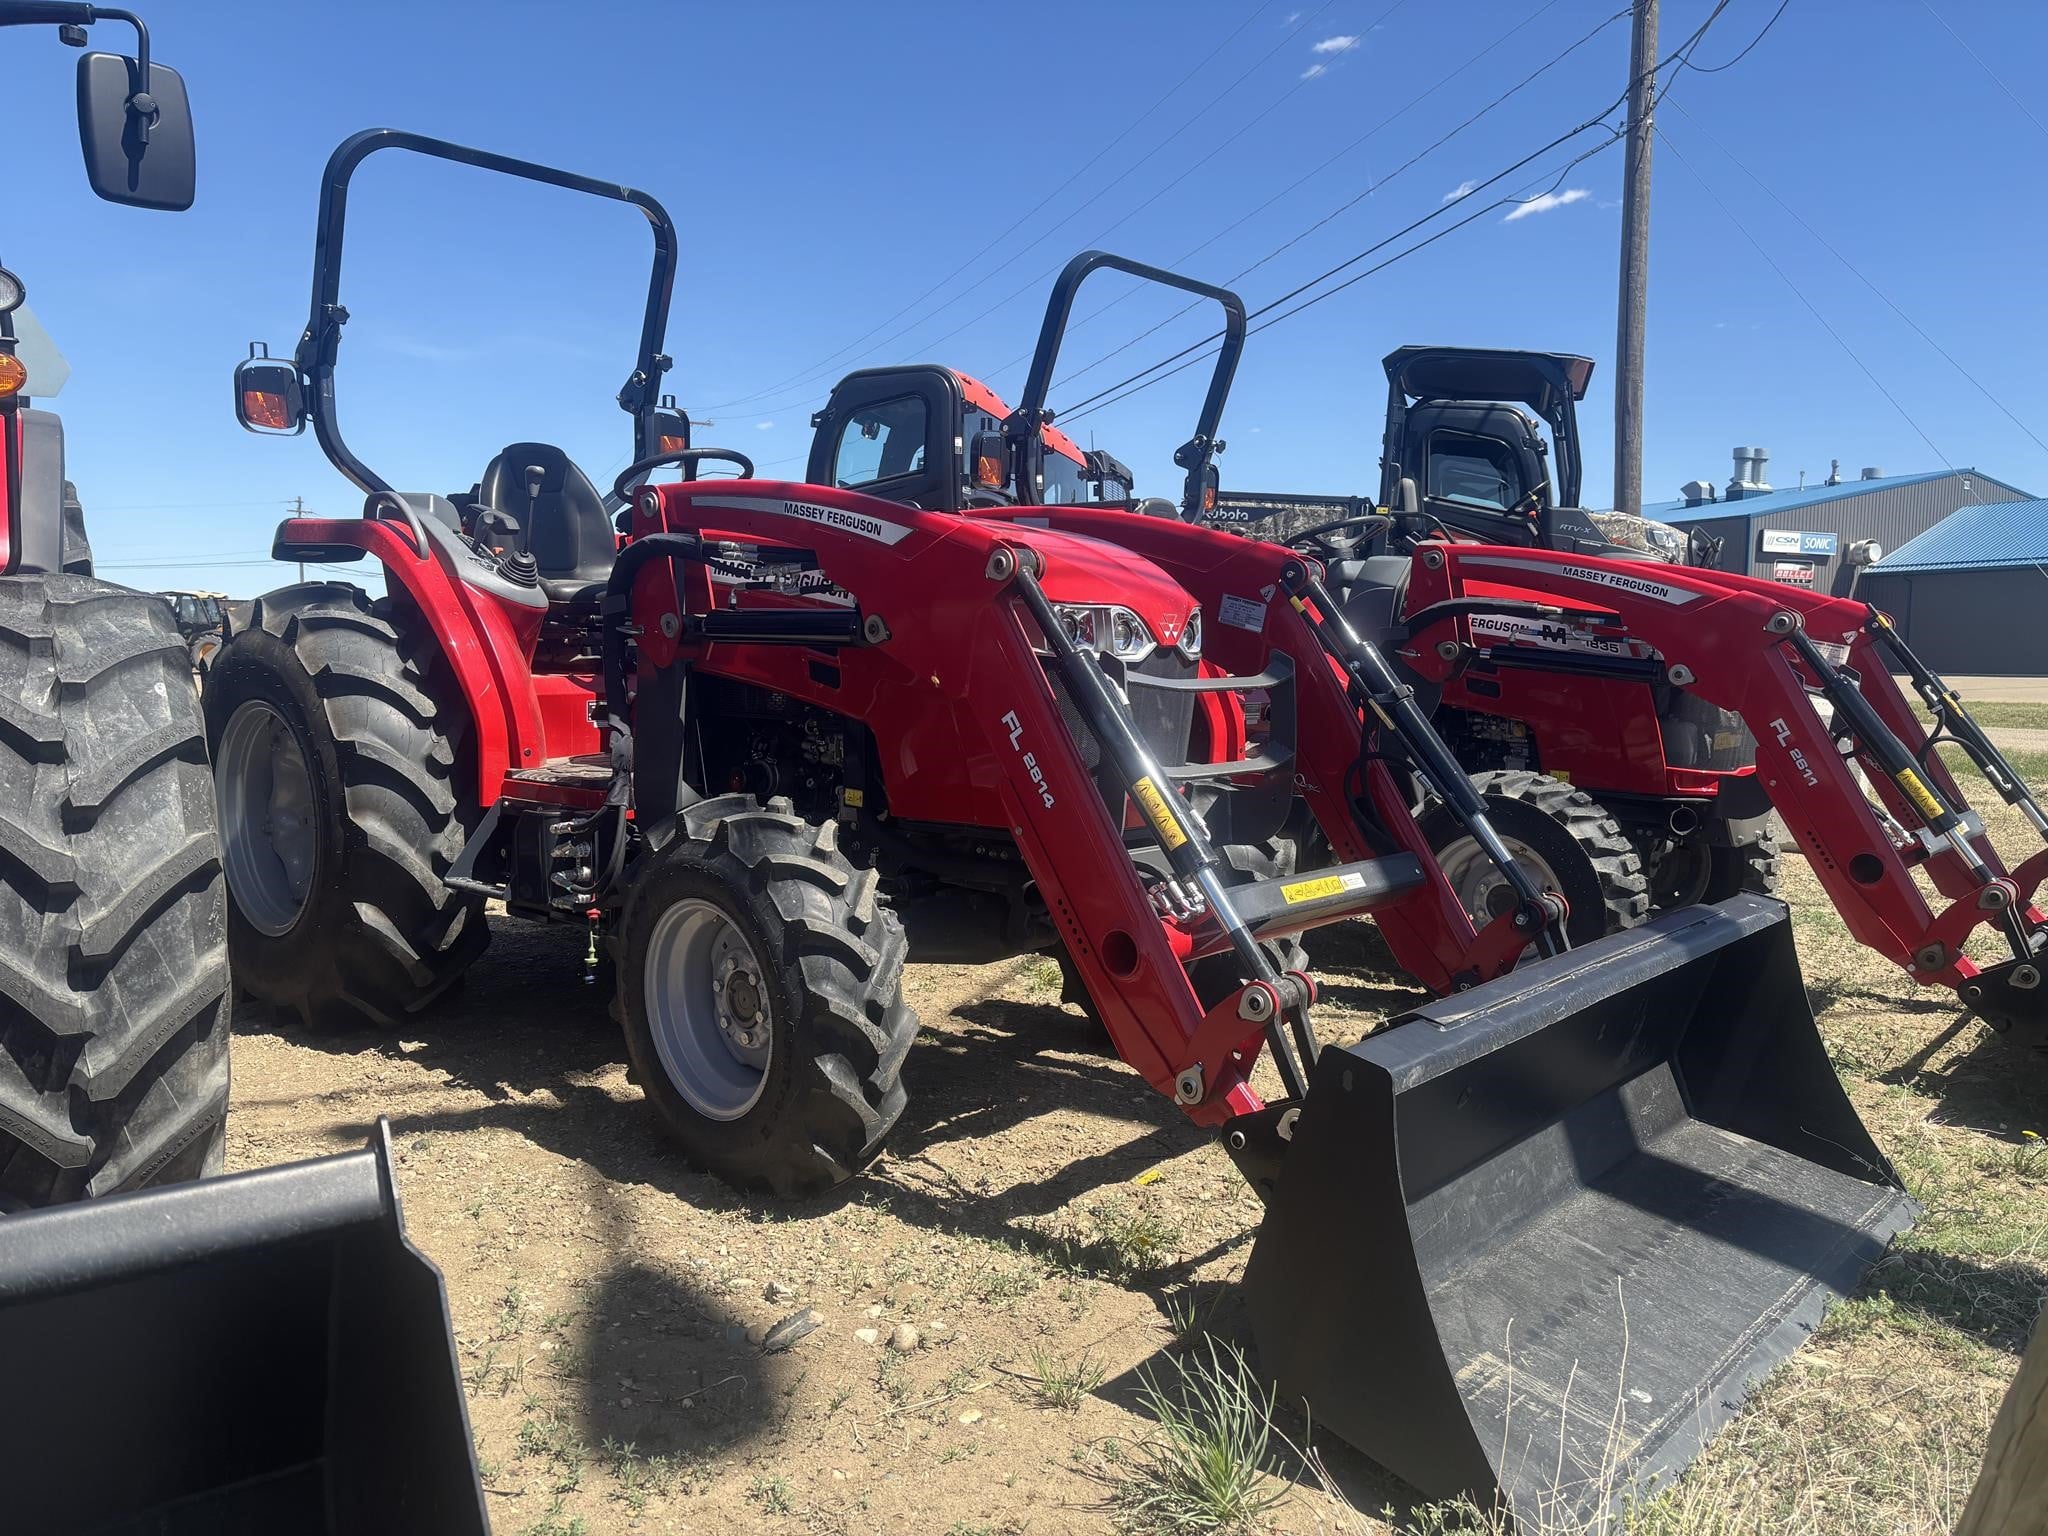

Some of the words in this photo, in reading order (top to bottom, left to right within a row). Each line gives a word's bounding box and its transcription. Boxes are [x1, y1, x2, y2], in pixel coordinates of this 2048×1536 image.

[784, 502, 825, 520] MASSEY
[827, 510, 882, 536] FERGUSON
[1560, 523, 1592, 534] RTV-X
[1776, 536, 1799, 544] CSN
[1805, 537, 1831, 549] SONIC
[1562, 566, 1607, 583] MASSEY
[1609, 575, 1669, 597] FERGUSON
[1471, 617, 1529, 632] ERGUSO
[1001, 710, 1023, 751] FL
[1023, 752, 1055, 809] 2814
[1769, 718, 1791, 748] FL
[1789, 748, 1818, 787] 2611
